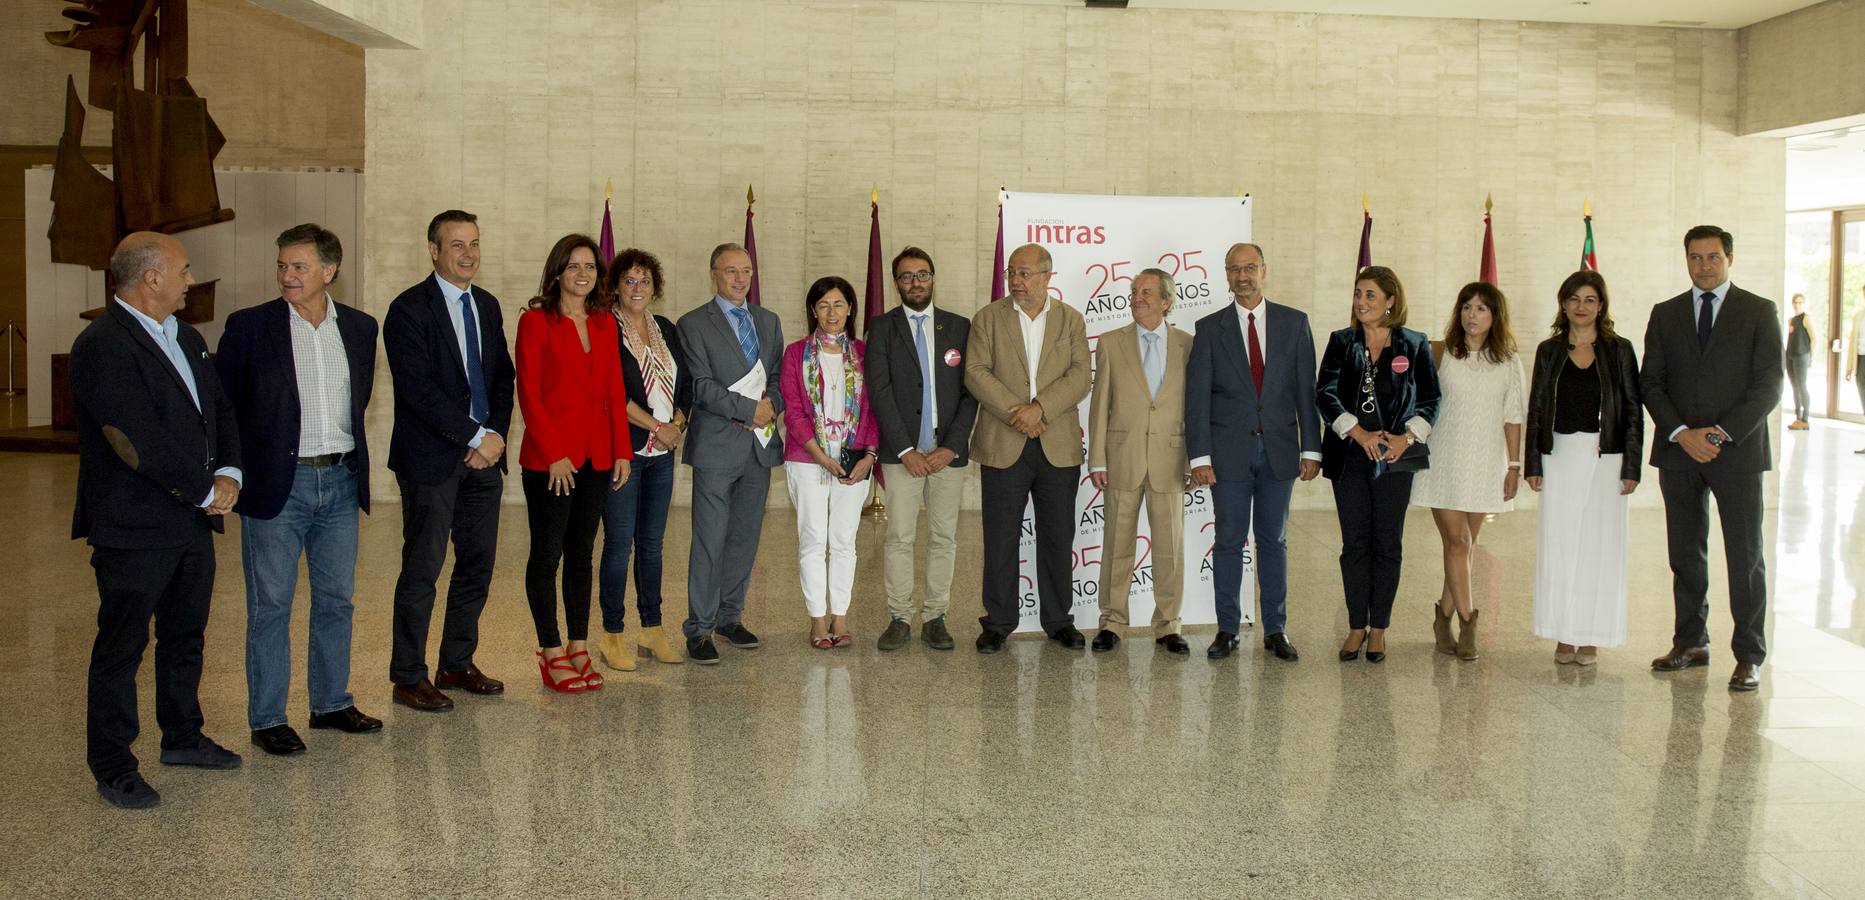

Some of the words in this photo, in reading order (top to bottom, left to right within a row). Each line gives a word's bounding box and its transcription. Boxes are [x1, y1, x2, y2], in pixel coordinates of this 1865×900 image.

[1027, 224, 1106, 244] intras
[1085, 261, 1133, 299] 25
[1175, 282, 1210, 300] ÑOS
[1098, 313, 1131, 321] HISTORI
[1185, 489, 1205, 507] OS
[1080, 504, 1104, 527] AÑ
